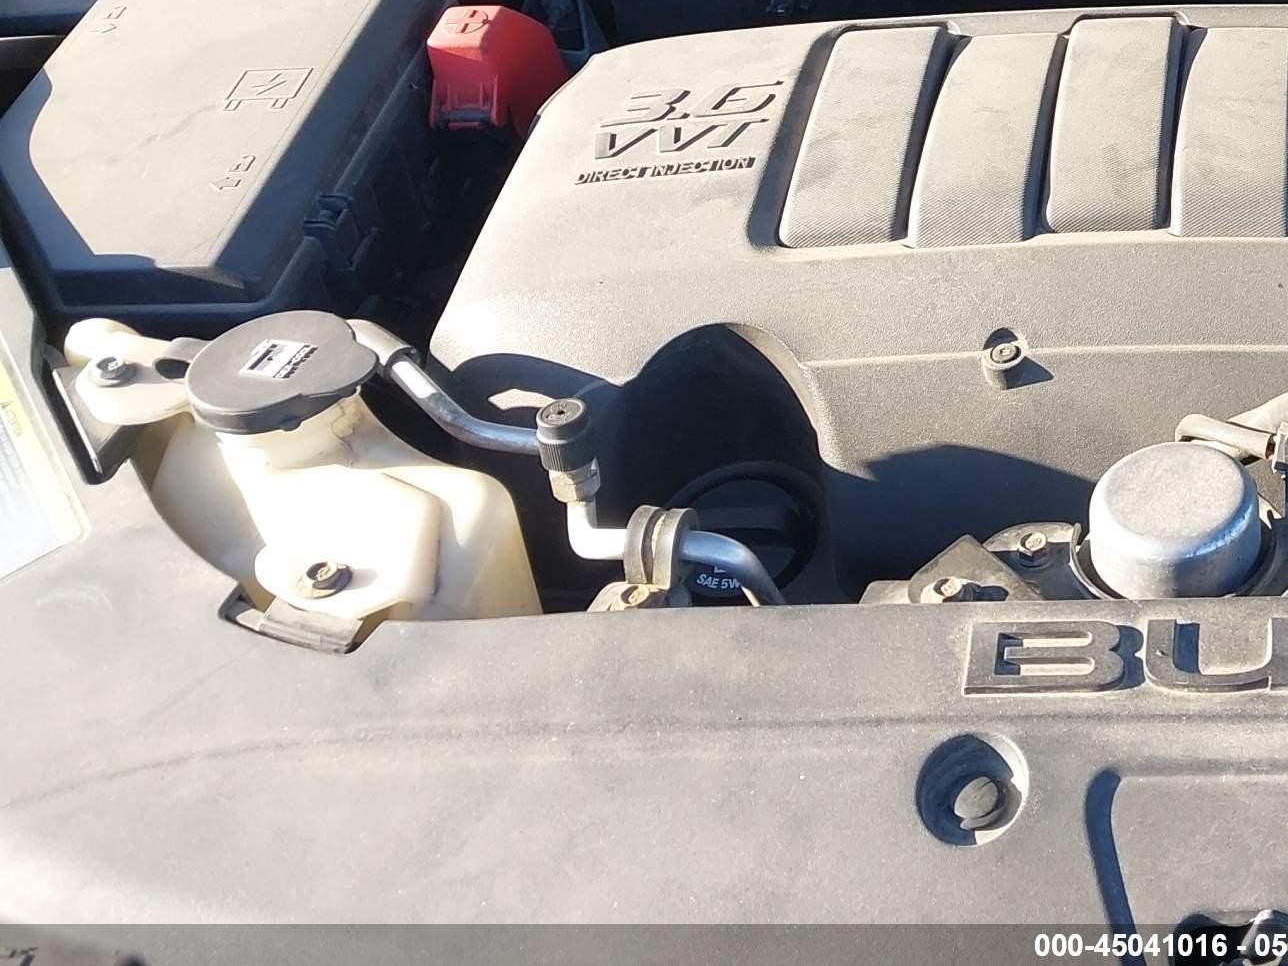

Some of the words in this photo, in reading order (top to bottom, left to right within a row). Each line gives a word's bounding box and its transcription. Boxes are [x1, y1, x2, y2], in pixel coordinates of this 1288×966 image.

[600, 81, 784, 127] 3.6
[595, 118, 769, 159] VVT
[575, 166, 650, 185] DIRECT
[650, 157, 756, 177] INJECTION
[696, 573, 719, 588] SAE
